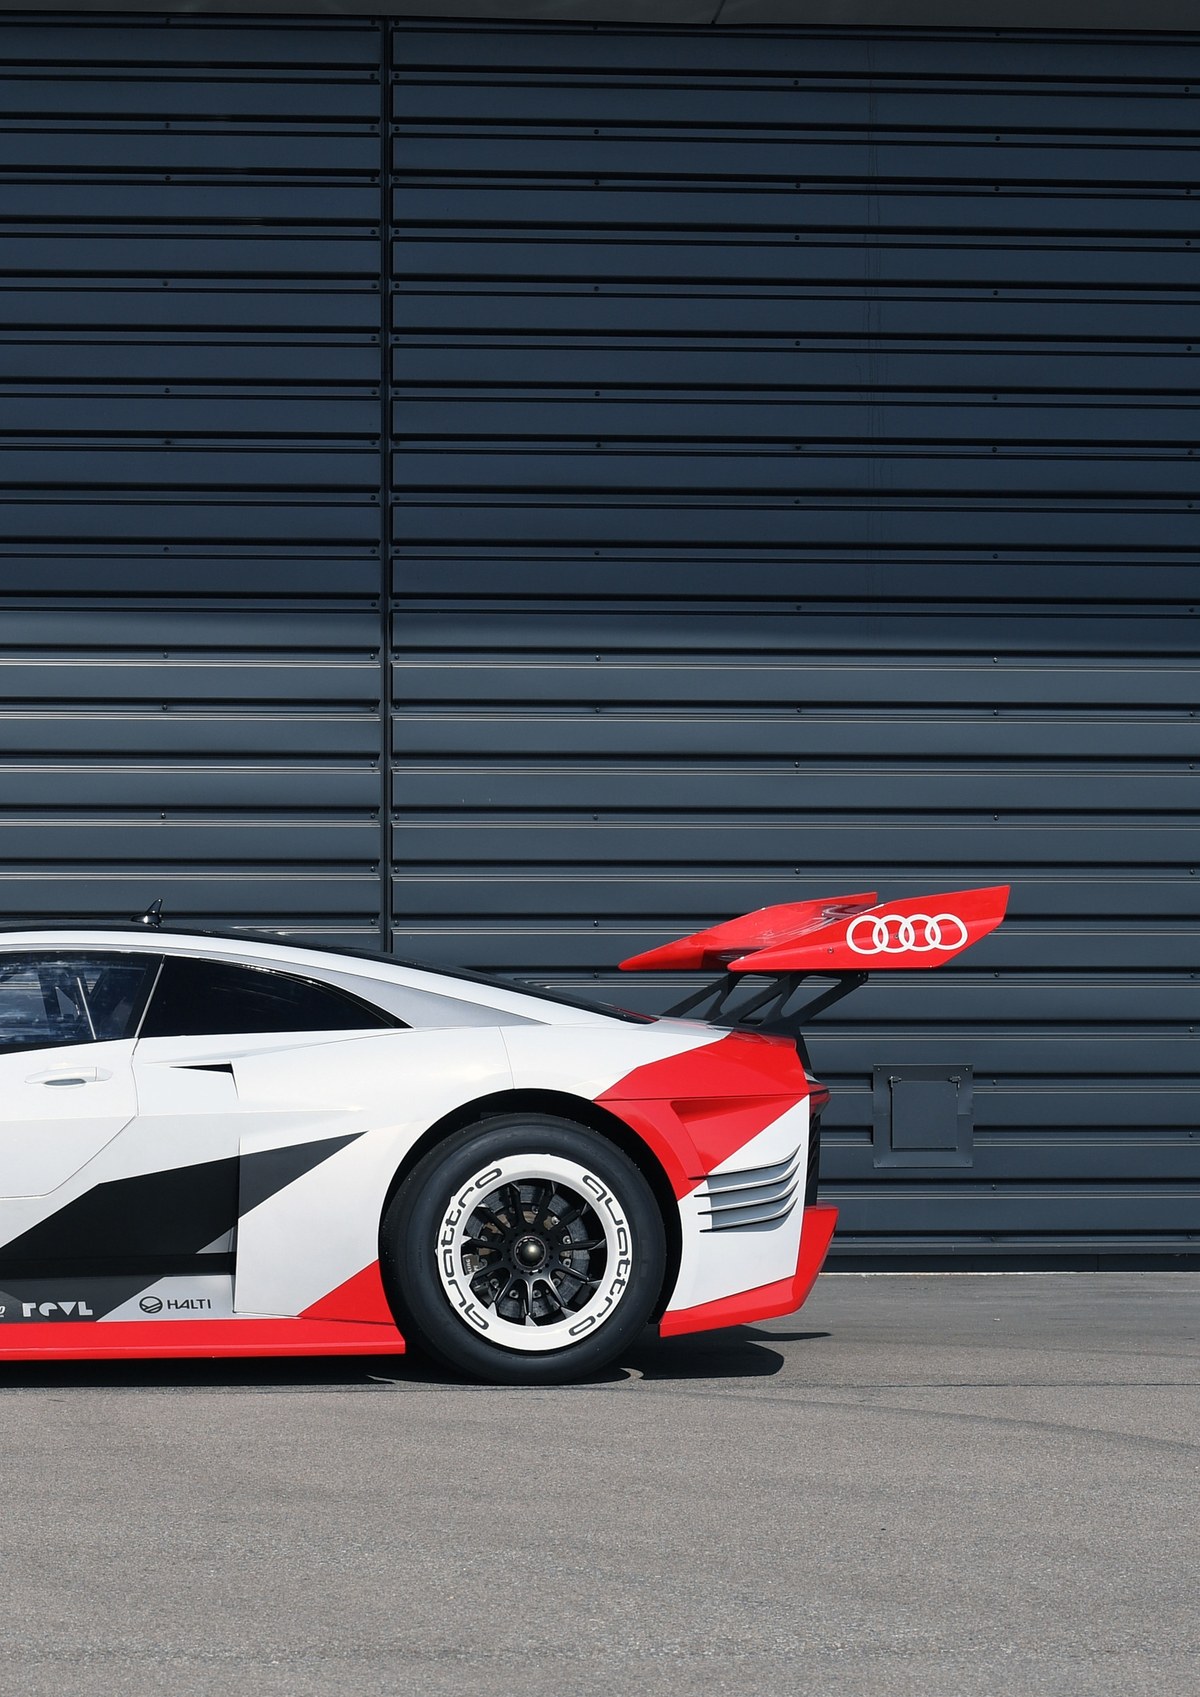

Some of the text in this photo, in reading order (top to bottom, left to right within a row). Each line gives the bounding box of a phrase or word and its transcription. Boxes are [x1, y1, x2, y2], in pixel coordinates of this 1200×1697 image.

[166, 1299, 212, 1310] HALTI
[440, 1168, 503, 1331] quattro
[569, 1174, 632, 1336] quattro
